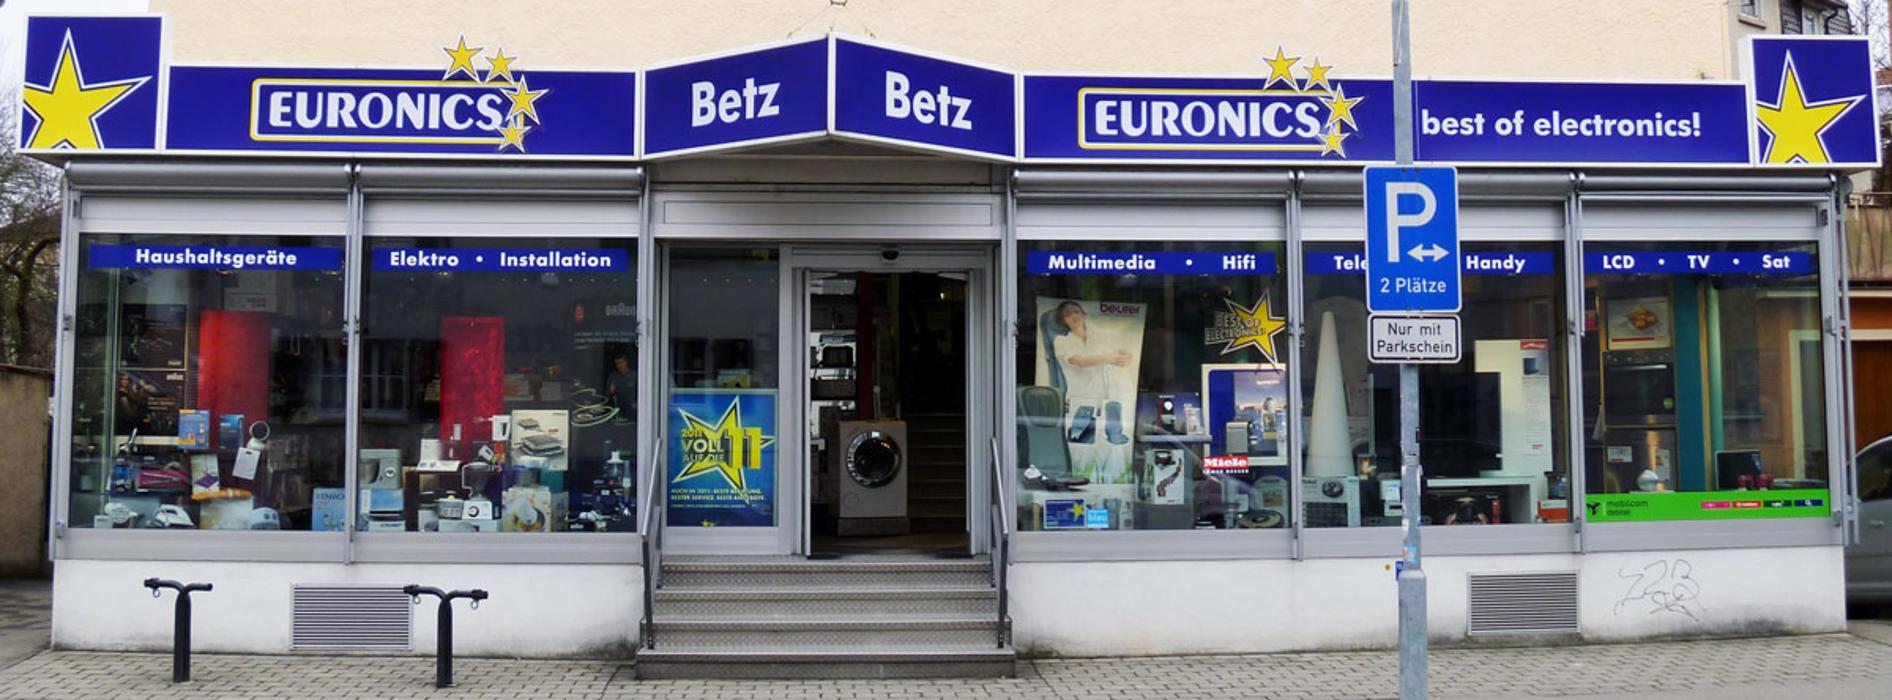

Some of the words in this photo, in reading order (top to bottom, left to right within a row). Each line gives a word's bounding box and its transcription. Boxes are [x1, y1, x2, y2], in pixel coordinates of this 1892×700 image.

[691, 78, 781, 127] Betz
[885, 71, 973, 130] Betz
[269, 91, 503, 131] EURONICS
[1095, 100, 1322, 138] EURONICS
[1421, 109, 1485, 136] best
[1494, 109, 1524, 136] of
[1533, 110, 1701, 137] electronics!
[1385, 181, 1437, 263] P
[136, 248, 297, 269] Haushaltsgeräte
[390, 250, 459, 267] Elektro
[500, 251, 611, 267] Installation
[1048, 254, 1156, 270] Multimedia
[1223, 254, 1256, 270] Hifi
[1466, 254, 1526, 274] Handy
[1603, 254, 1635, 269] LCD
[1687, 255, 1710, 269] TV
[1762, 254, 1790, 269] Sat
[1380, 277, 1390, 293] 2
[1395, 277, 1447, 293] Plätze
[1100, 303, 1140, 314] beurer
[1387, 322, 1413, 336] Nur
[1420, 322, 1442, 336] mit
[1377, 340, 1454, 353] Parkschein
[681, 439, 725, 453] VOLL
[725, 427, 762, 469] 11
[1203, 457, 1248, 467] Miele
